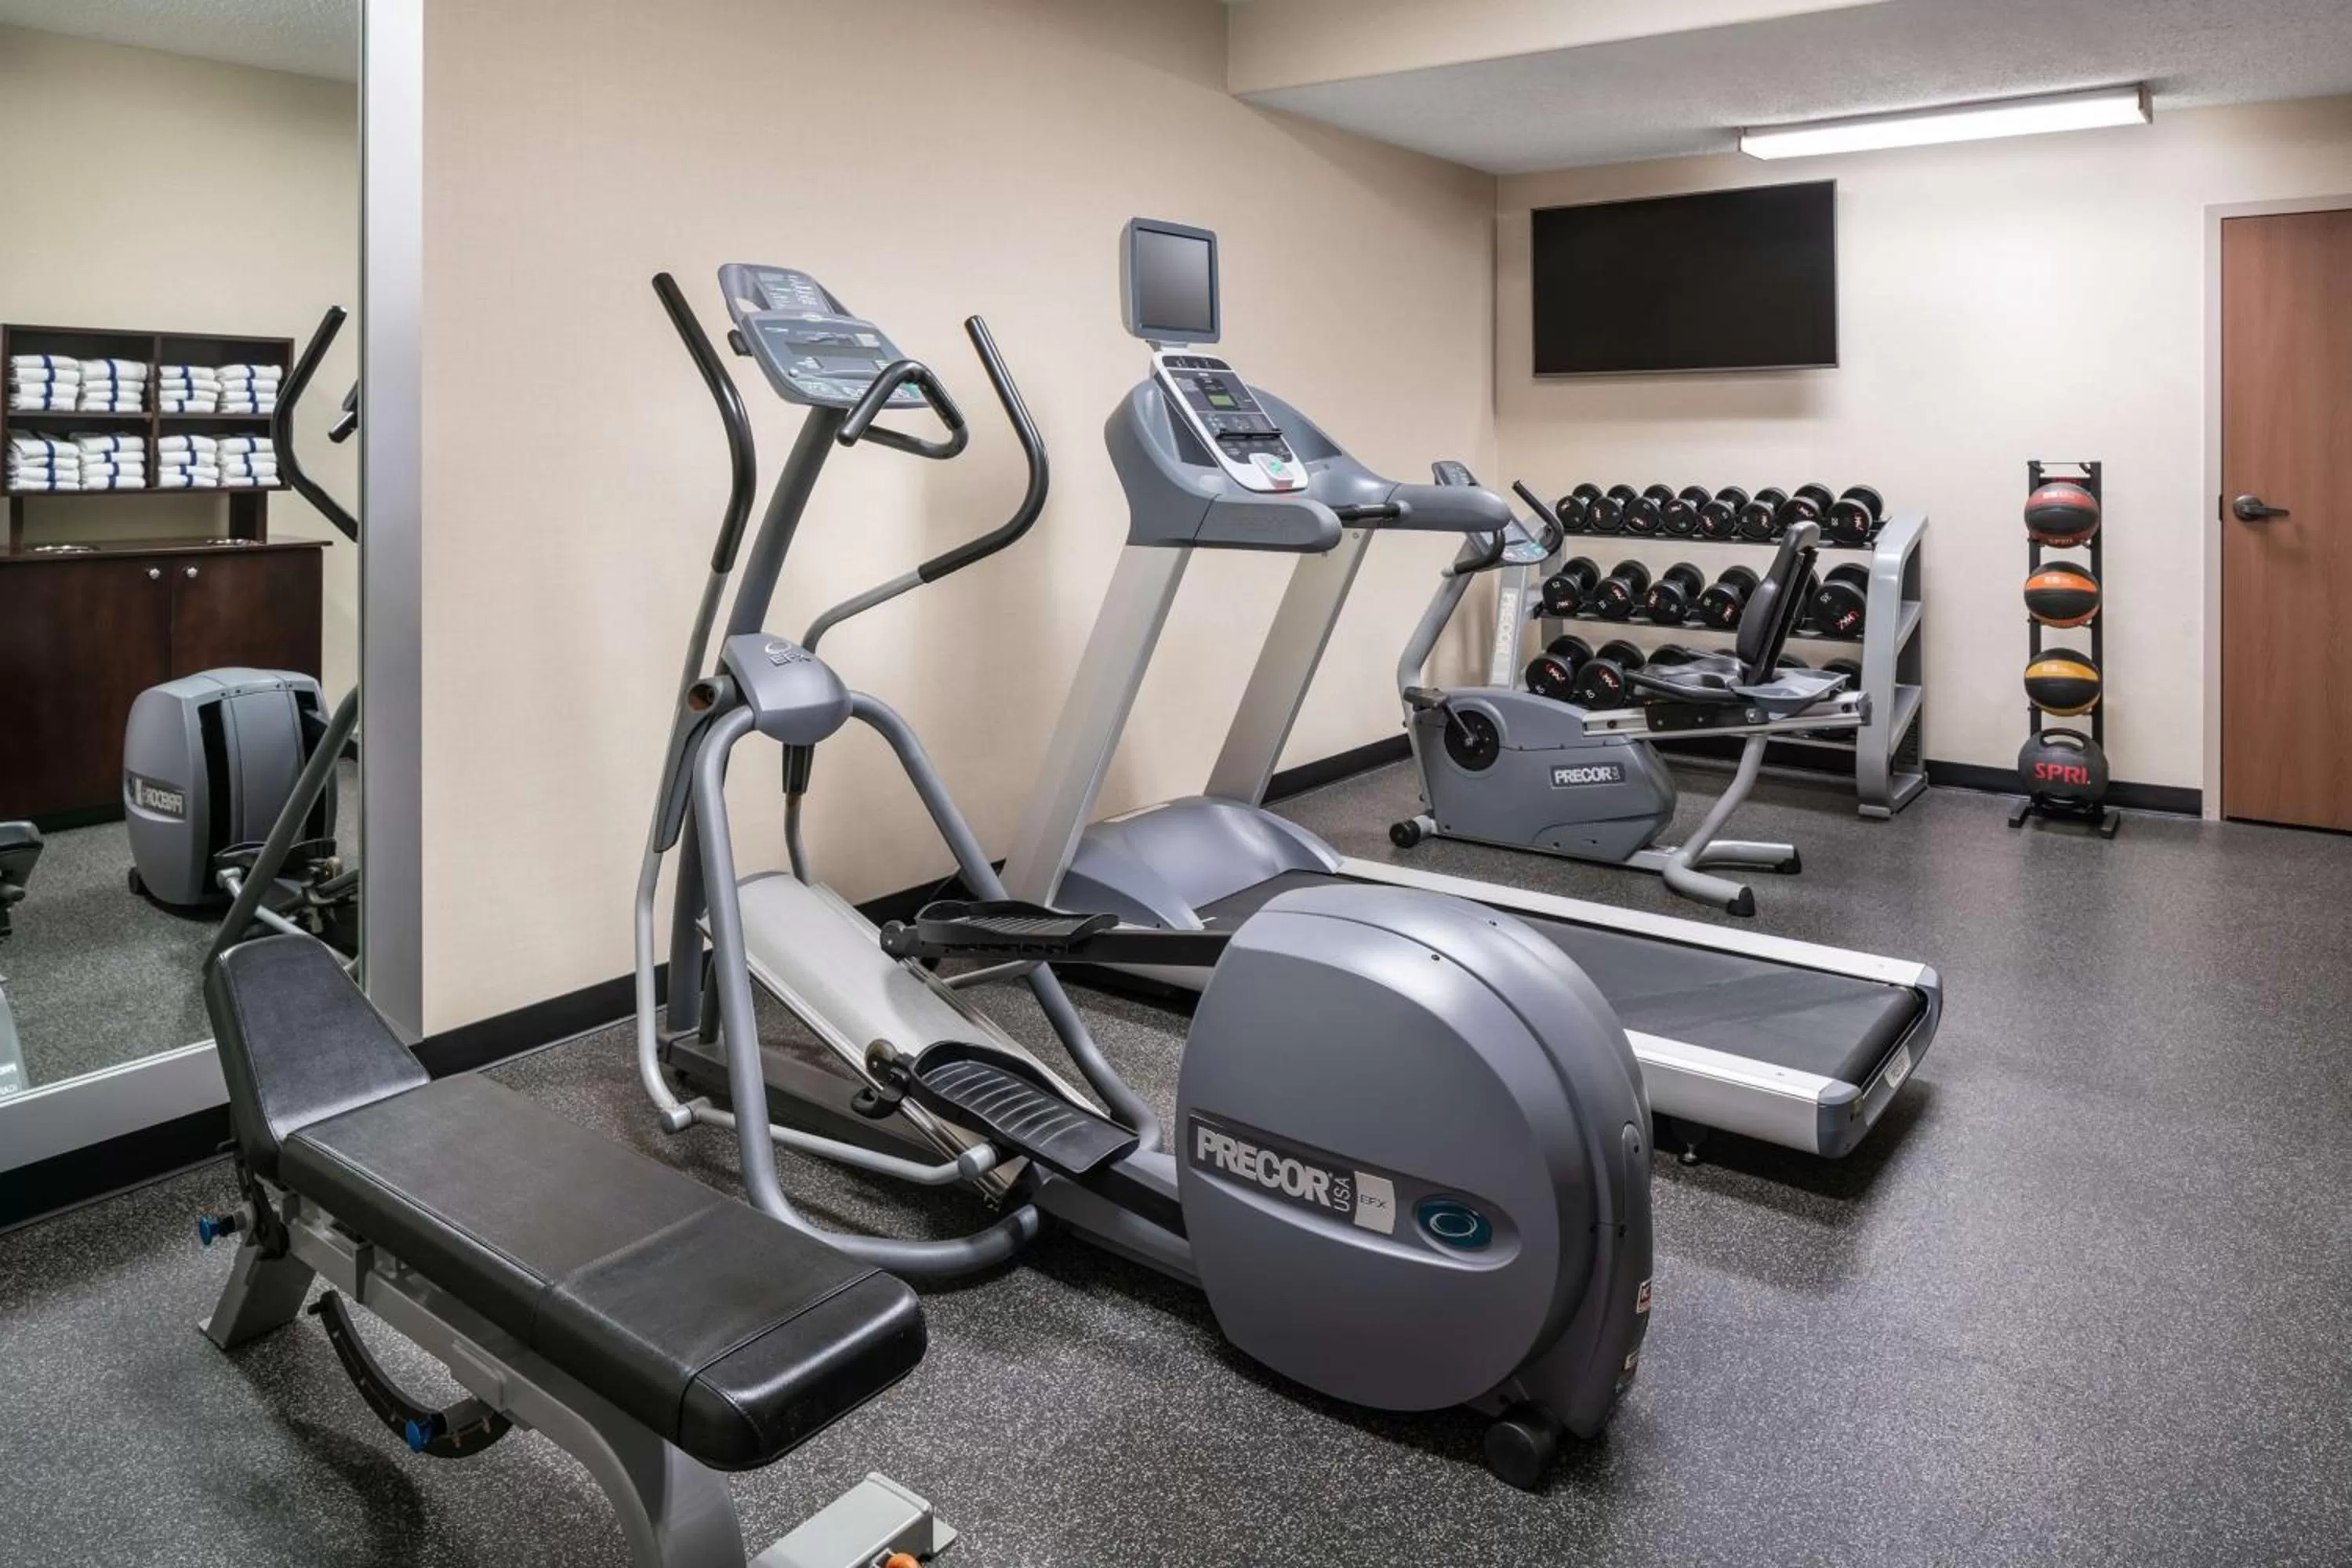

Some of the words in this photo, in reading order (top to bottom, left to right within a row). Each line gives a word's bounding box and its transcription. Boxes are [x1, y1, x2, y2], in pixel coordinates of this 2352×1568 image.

[1554, 767, 1612, 785] PRECOR
[1197, 1125, 1331, 1208] PRECOR
[1334, 1177, 1350, 1212] USA
